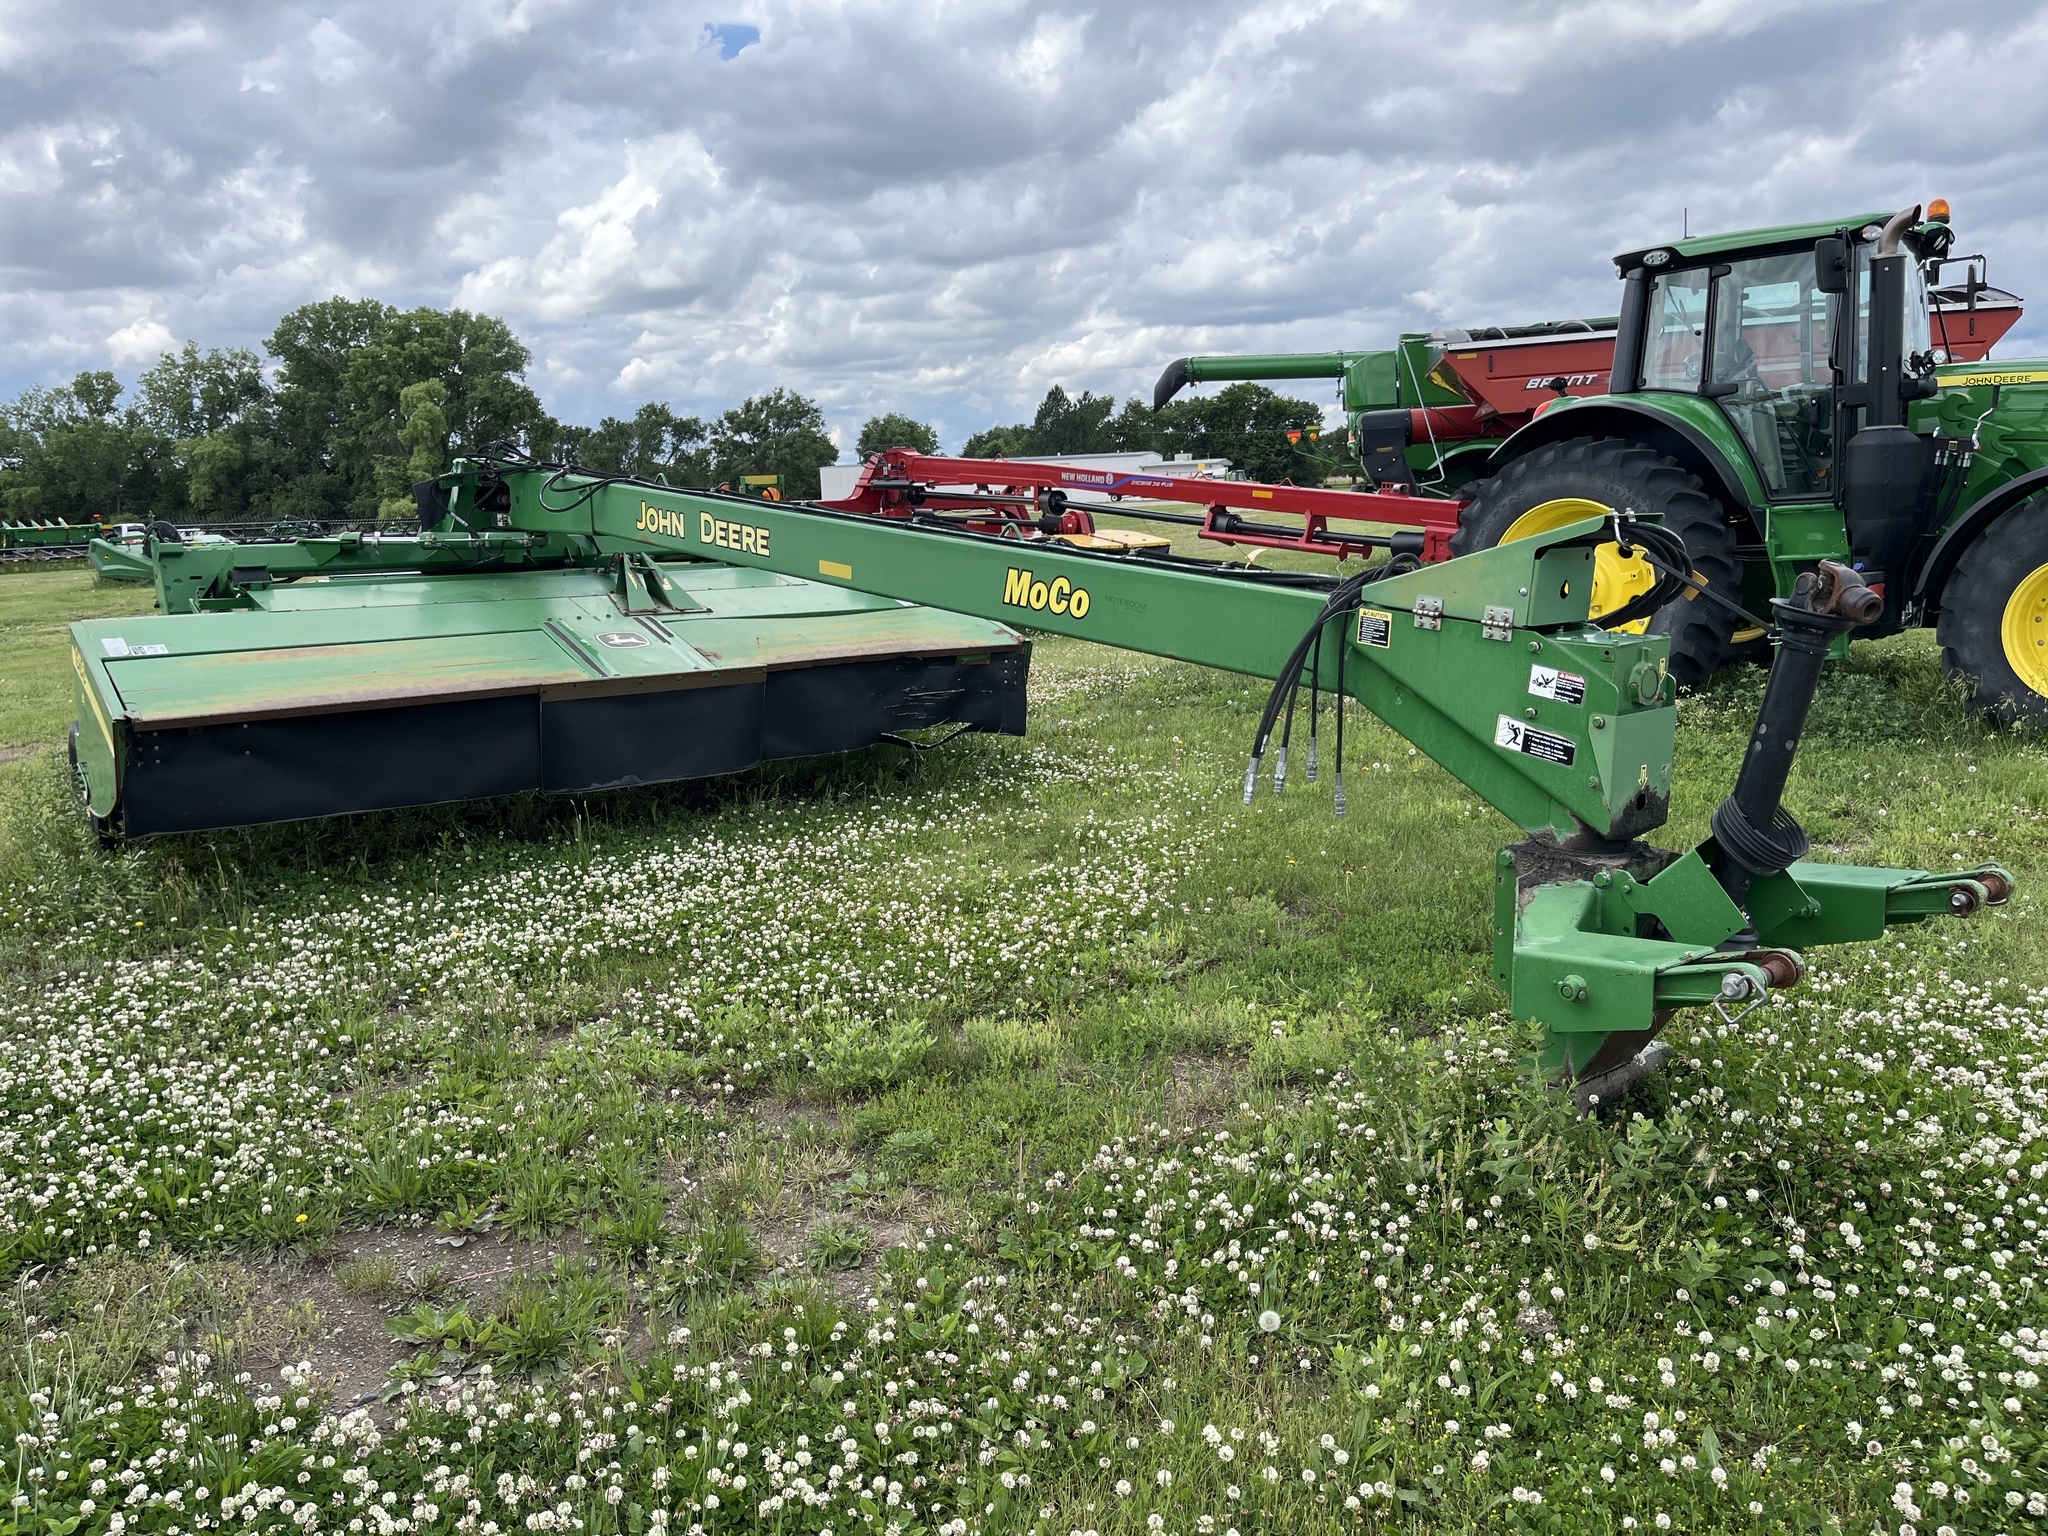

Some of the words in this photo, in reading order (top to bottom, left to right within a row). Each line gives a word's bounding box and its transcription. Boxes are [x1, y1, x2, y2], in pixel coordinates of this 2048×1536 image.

[1525, 374, 1598, 389] BRNT
[1962, 377, 1992, 386] JOHN
[1993, 375, 2032, 384] DEERE
[1061, 472, 1076, 482] NEW
[1076, 473, 1105, 485] HOLLAND
[636, 500, 685, 539] JOHN
[699, 510, 770, 558] DEERE
[1002, 566, 1091, 620] MoCo
[1104, 595, 1147, 611] NOTEBOOM
